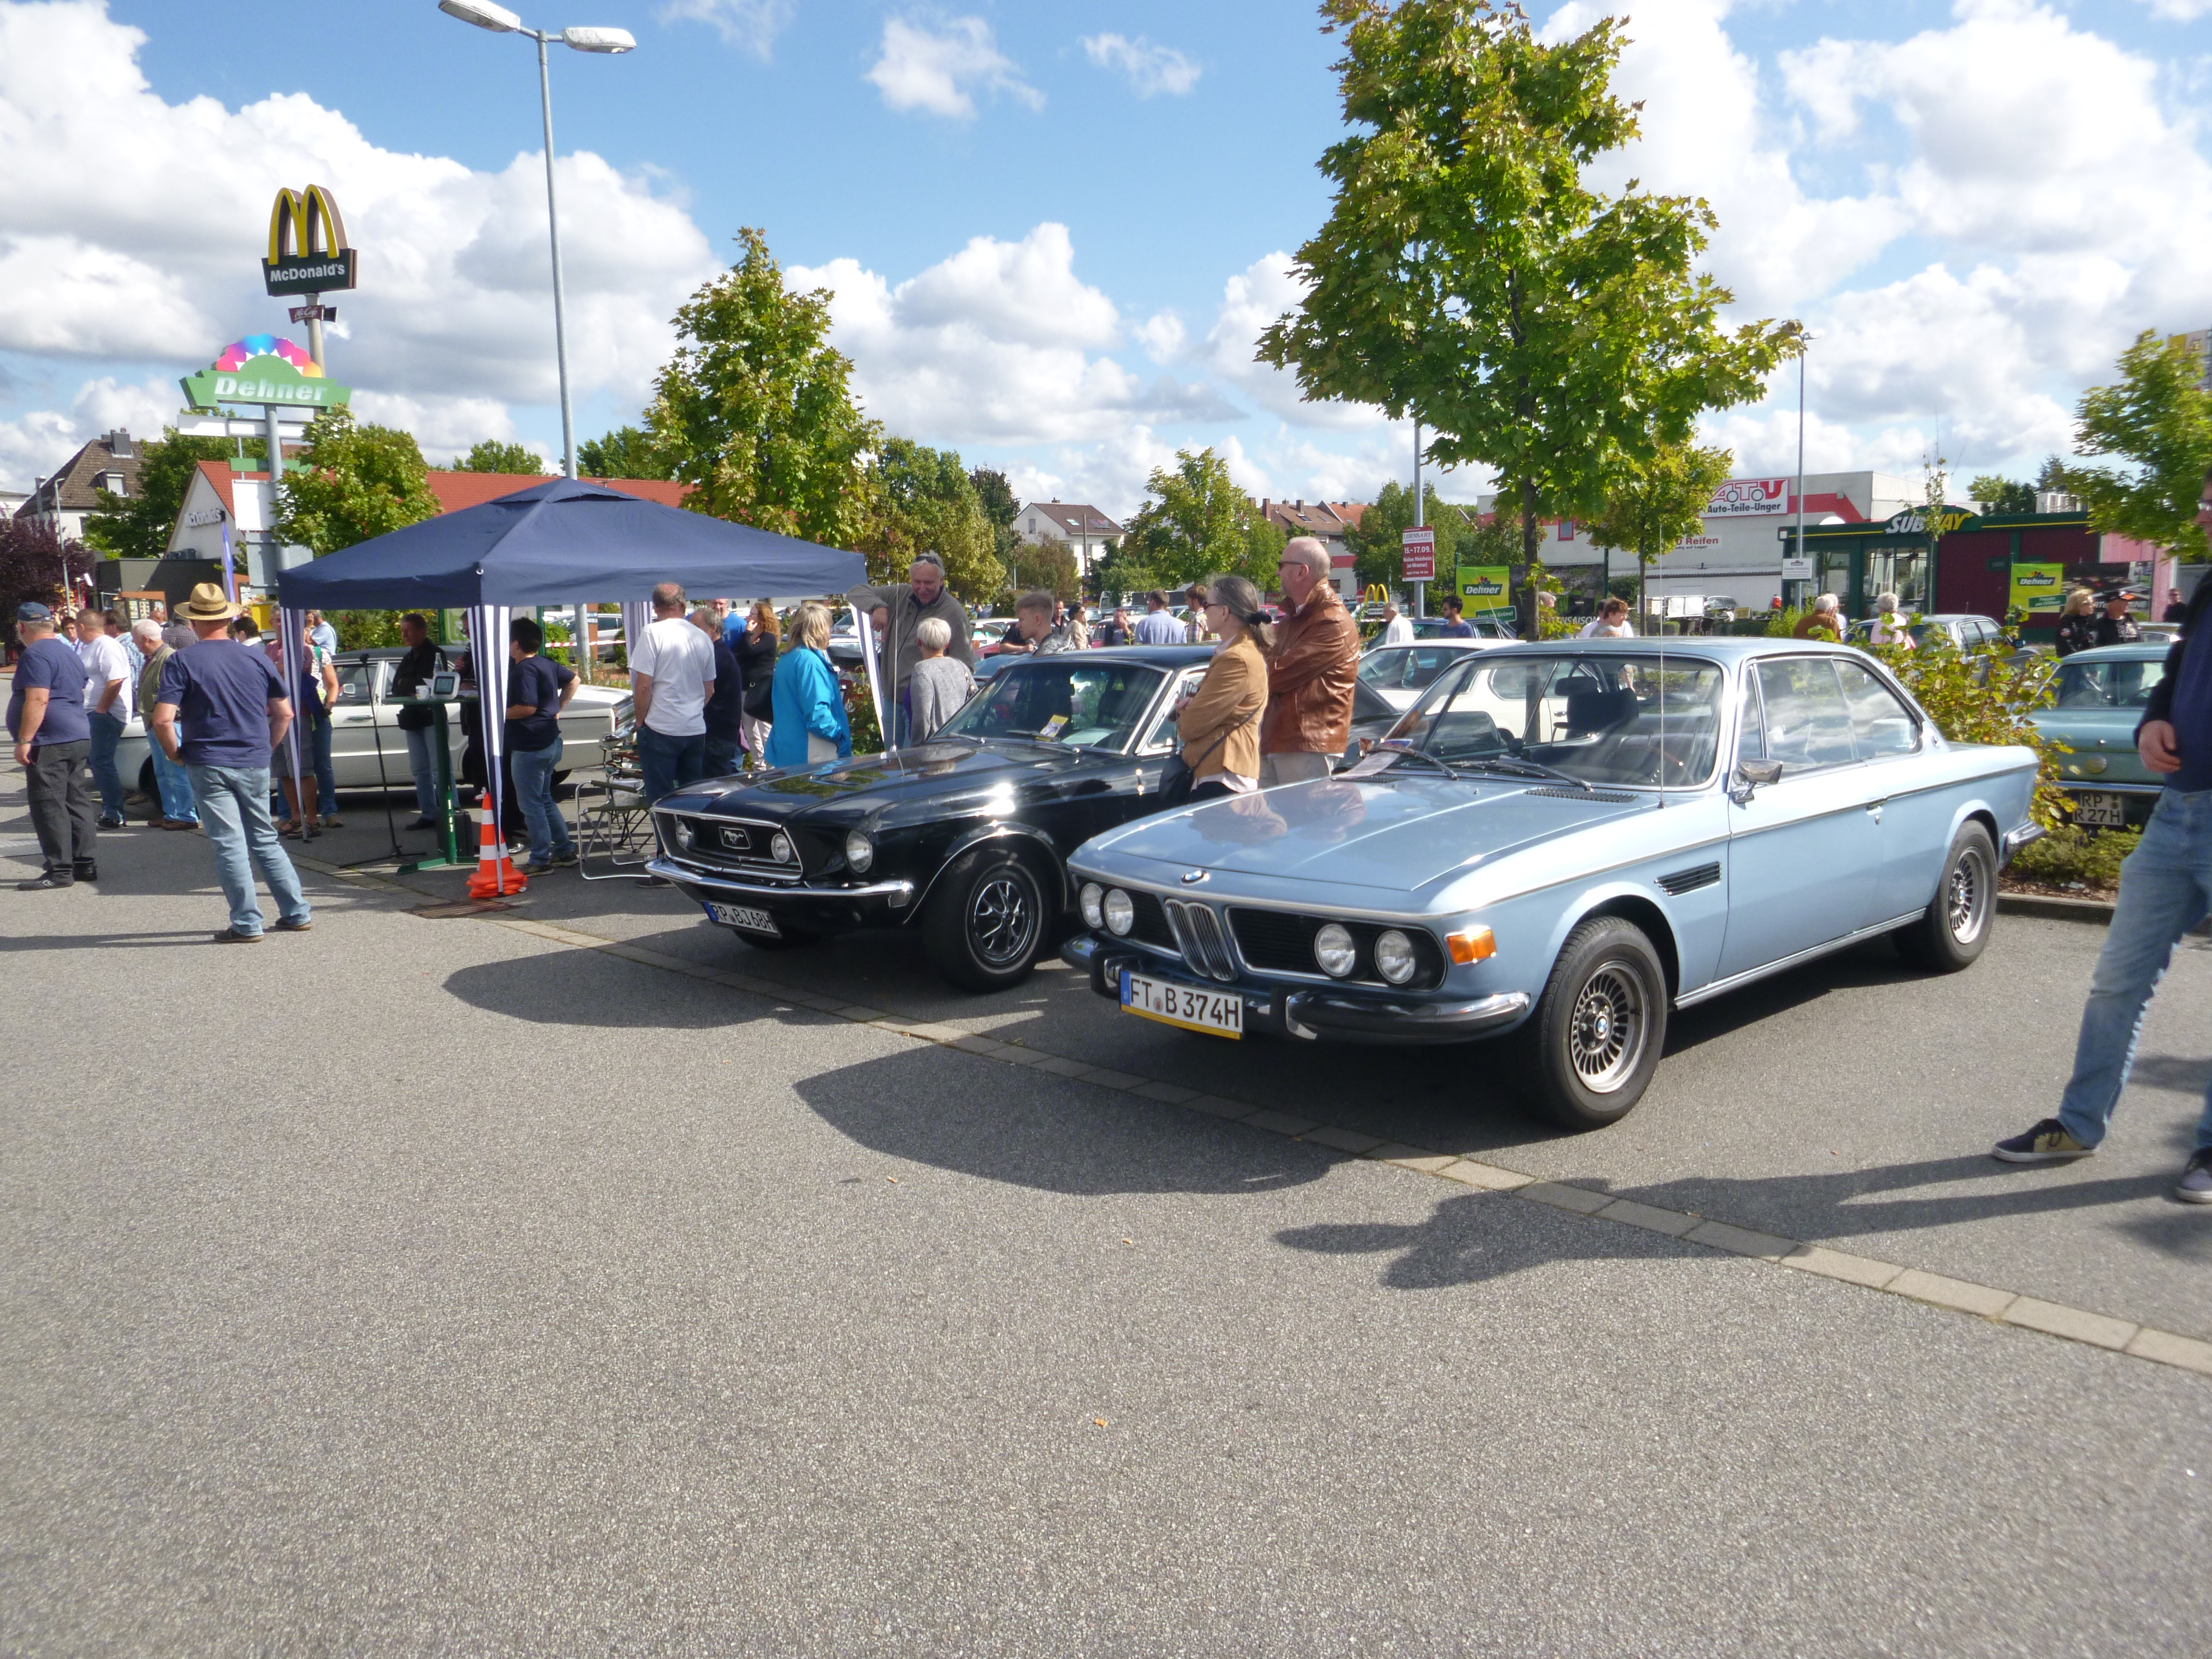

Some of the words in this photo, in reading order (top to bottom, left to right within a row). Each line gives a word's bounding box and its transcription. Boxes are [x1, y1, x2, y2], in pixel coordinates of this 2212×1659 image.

[270, 264, 345, 282] McDonald's
[215, 376, 327, 400] Dehner
[1707, 503, 1781, 513] Auto-Teile-Unger
[2082, 794, 2102, 807] RP
[711, 904, 727, 921] RP
[1130, 978, 1152, 1007] FT
[1166, 987, 1177, 1014] B
[1183, 991, 1239, 1028] 374H
